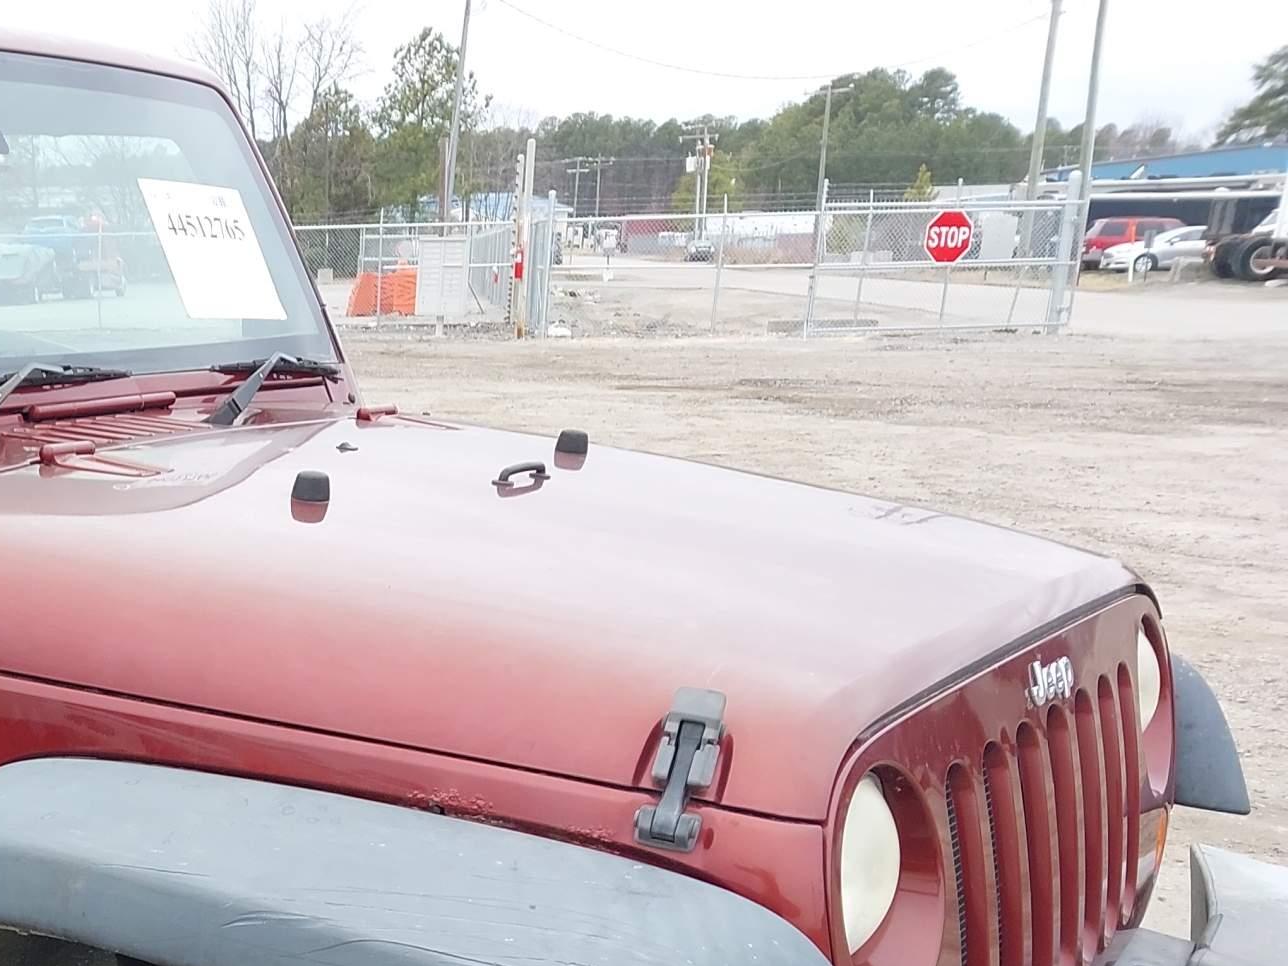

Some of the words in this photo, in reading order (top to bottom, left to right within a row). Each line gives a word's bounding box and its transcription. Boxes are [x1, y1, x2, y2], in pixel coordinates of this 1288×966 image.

[168, 213, 245, 241] 44512765
[928, 226, 970, 248] STOP
[1026, 655, 1074, 706] Jeep
